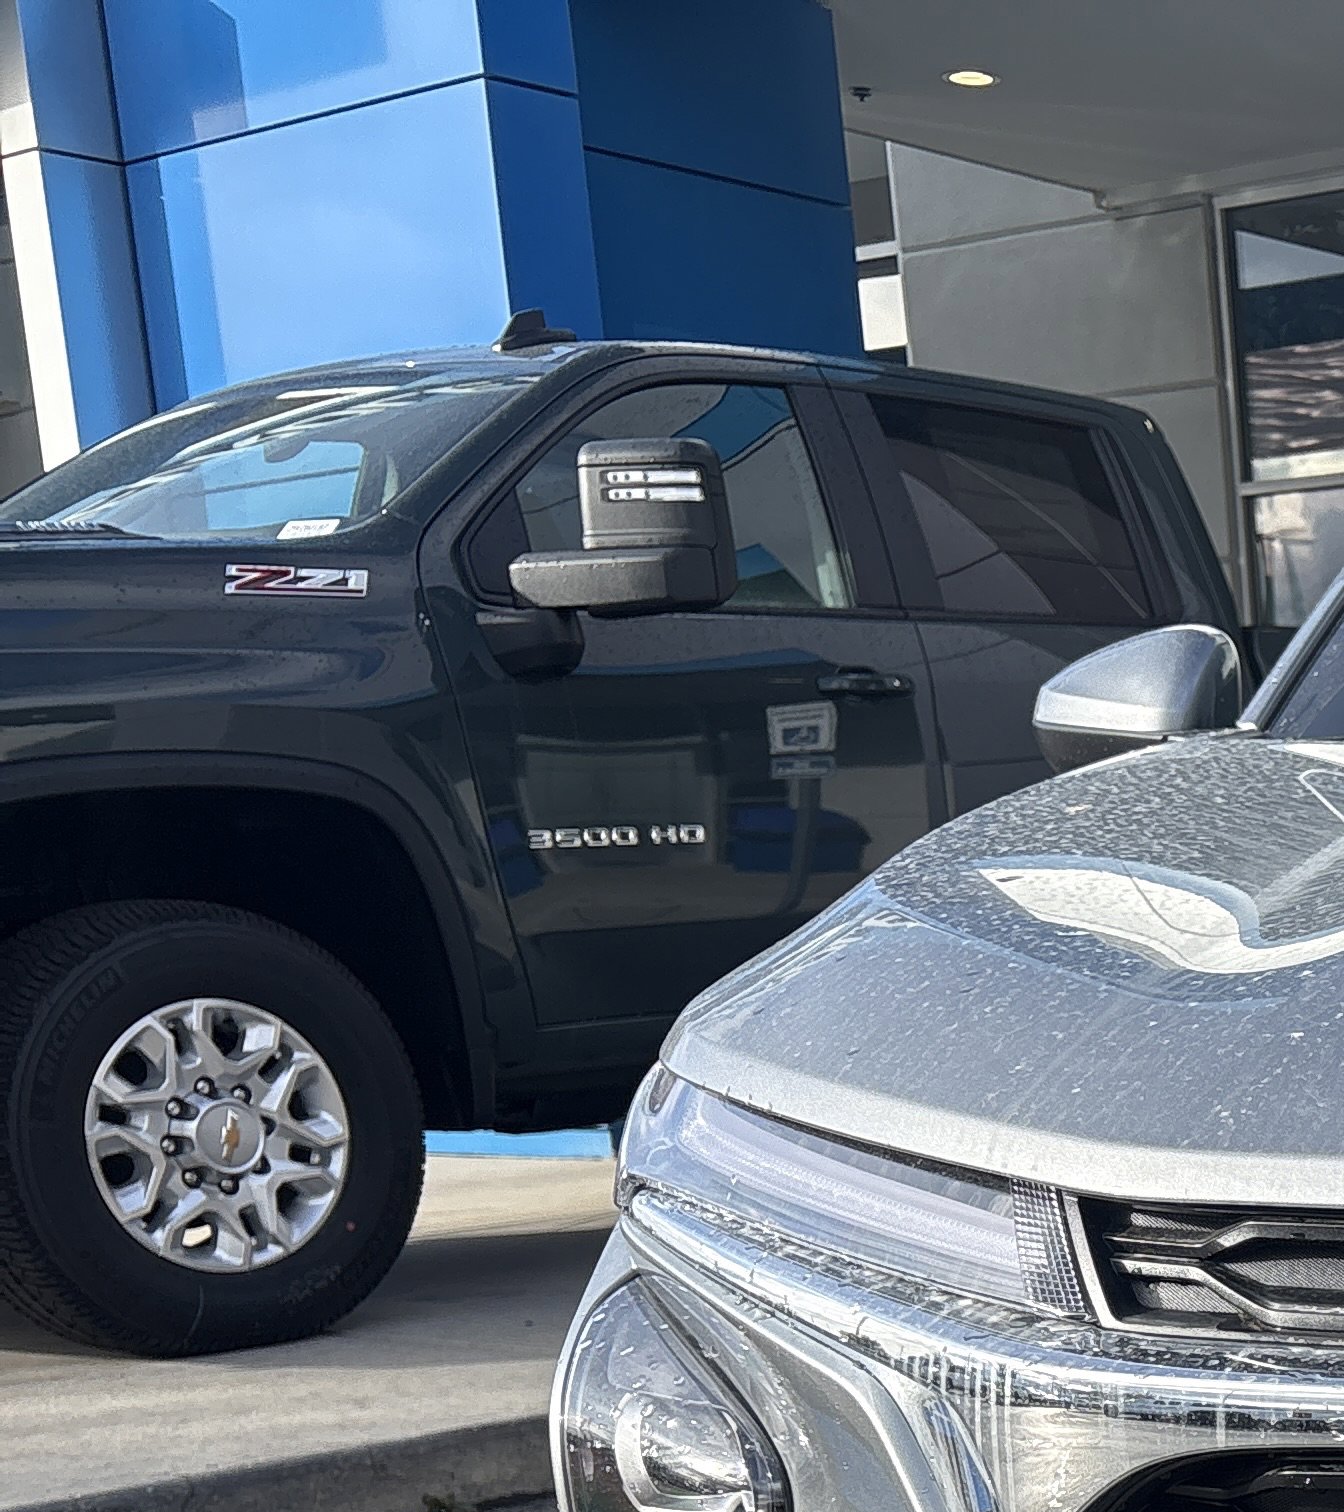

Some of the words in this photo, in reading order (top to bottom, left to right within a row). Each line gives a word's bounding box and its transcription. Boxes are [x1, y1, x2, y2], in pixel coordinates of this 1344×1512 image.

[225, 565, 368, 597] Z71
[528, 827, 639, 849] 3500
[650, 824, 705, 844] HD
